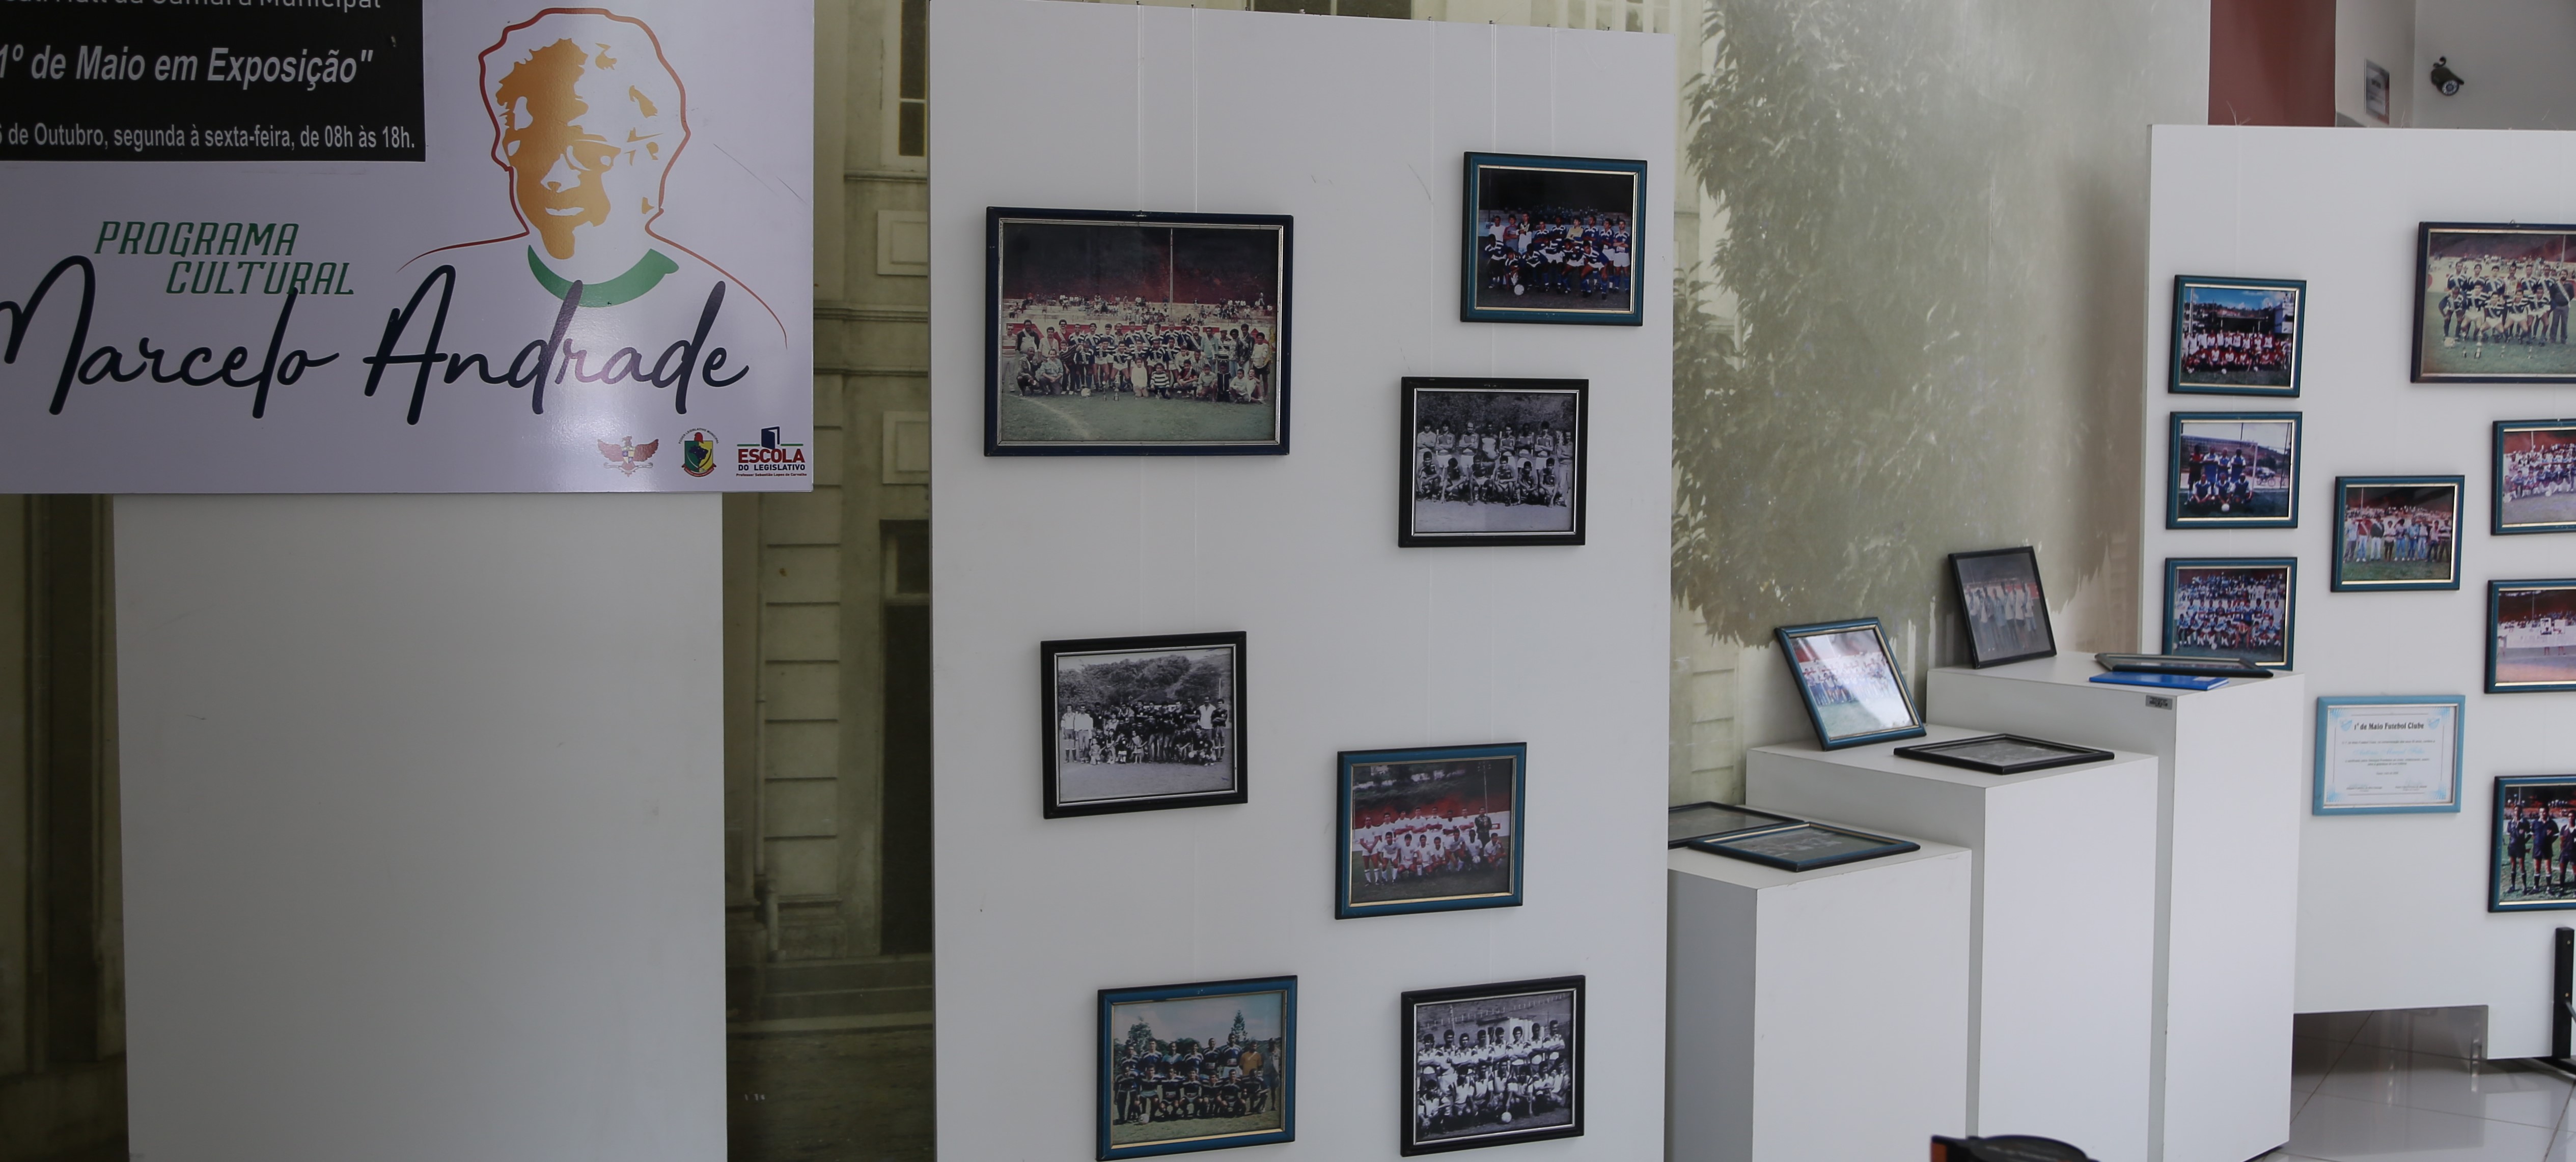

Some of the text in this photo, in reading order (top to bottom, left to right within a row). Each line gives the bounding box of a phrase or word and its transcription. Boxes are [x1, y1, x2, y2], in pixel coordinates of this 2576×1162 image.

[32, 45, 66, 79] de
[76, 46, 145, 80] Maio
[155, 55, 198, 81] em
[208, 48, 374, 91] Exposição"
[9, 122, 29, 145] de
[35, 123, 108, 150] Outubro,
[114, 124, 185, 152] segunda
[191, 124, 200, 147] à
[205, 125, 294, 151] sexta-feira,
[300, 125, 319, 147] de
[325, 126, 353, 148] 08h
[359, 125, 377, 148] às
[383, 126, 414, 148] 18h.
[94, 221, 299, 258] PROGRAMA
[166, 261, 354, 295] CULTURAL
[0, 255, 750, 426] Marcelo Andrade
[738, 448, 806, 463] ESCOLA
